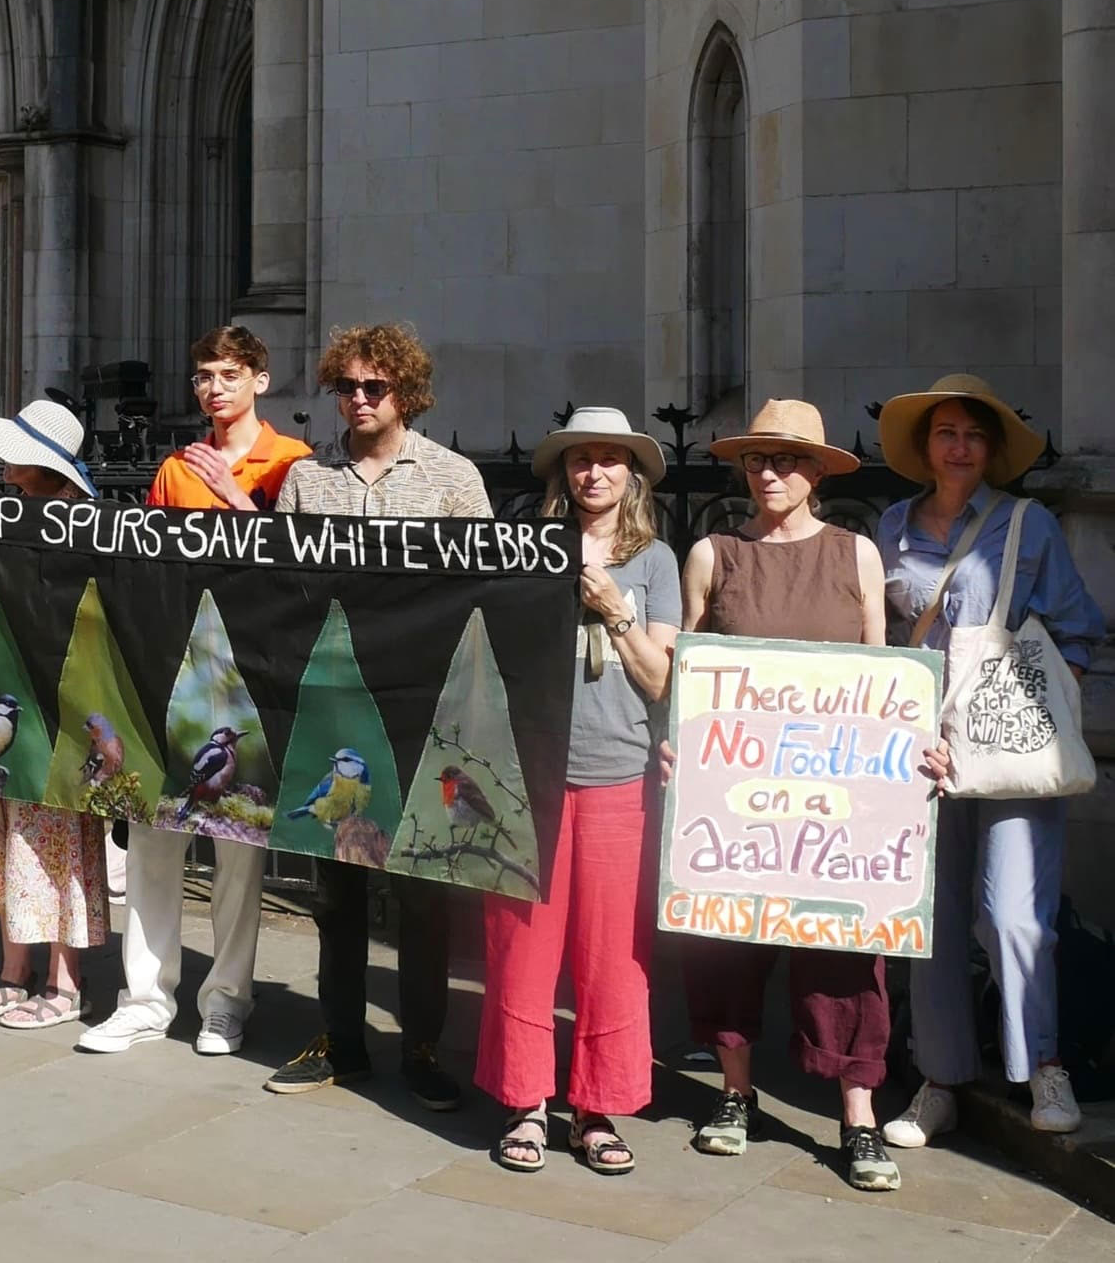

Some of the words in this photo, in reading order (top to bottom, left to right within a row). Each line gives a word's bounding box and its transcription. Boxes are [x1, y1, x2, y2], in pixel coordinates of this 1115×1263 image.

[813, 674, 873, 716] will
[879, 677, 921, 722] be
[700, 719, 767, 770] No
[772, 722, 913, 783] Football
[747, 788, 790, 814] on
[804, 793, 832, 816] a
[682, 815, 784, 875] dead
[664, 892, 755, 938] CHRIS
